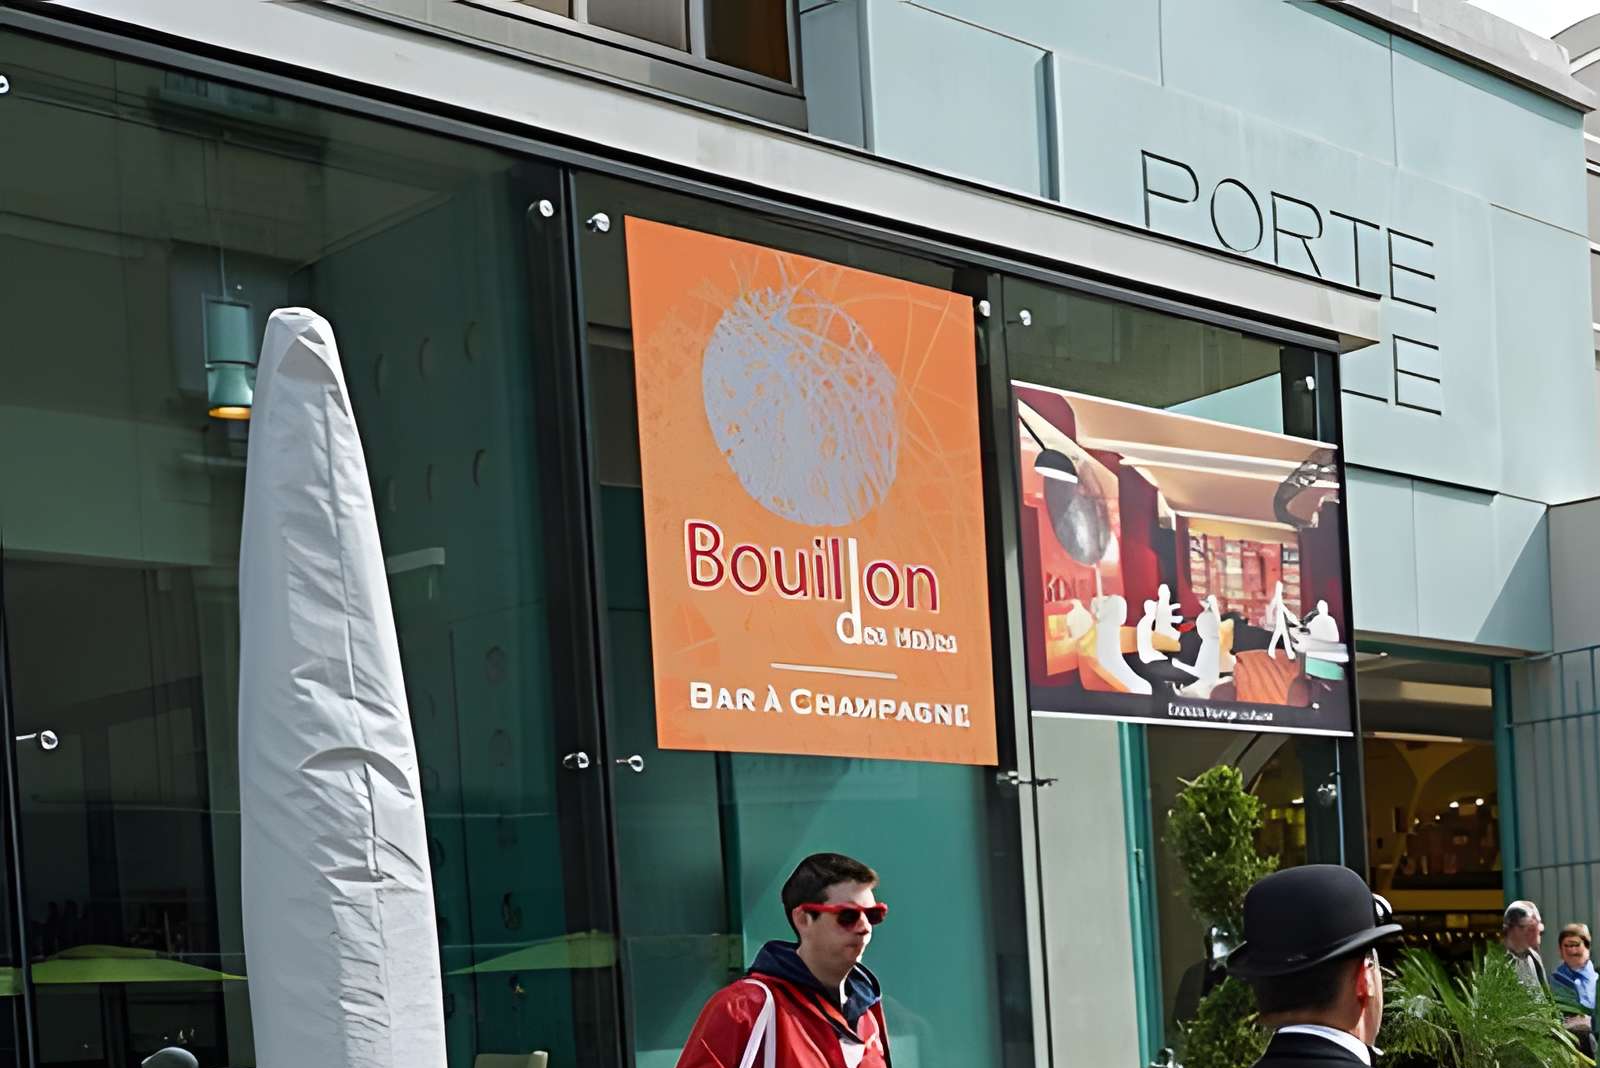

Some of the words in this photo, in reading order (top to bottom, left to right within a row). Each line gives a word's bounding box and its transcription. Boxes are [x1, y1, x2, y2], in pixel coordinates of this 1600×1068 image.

[1141, 149, 1437, 313] PORTE
[683, 518, 940, 615] Bouillon
[689, 681, 756, 712] BAR
[763, 684, 783, 714] À
[789, 688, 971, 728] CHAMPAGNE
